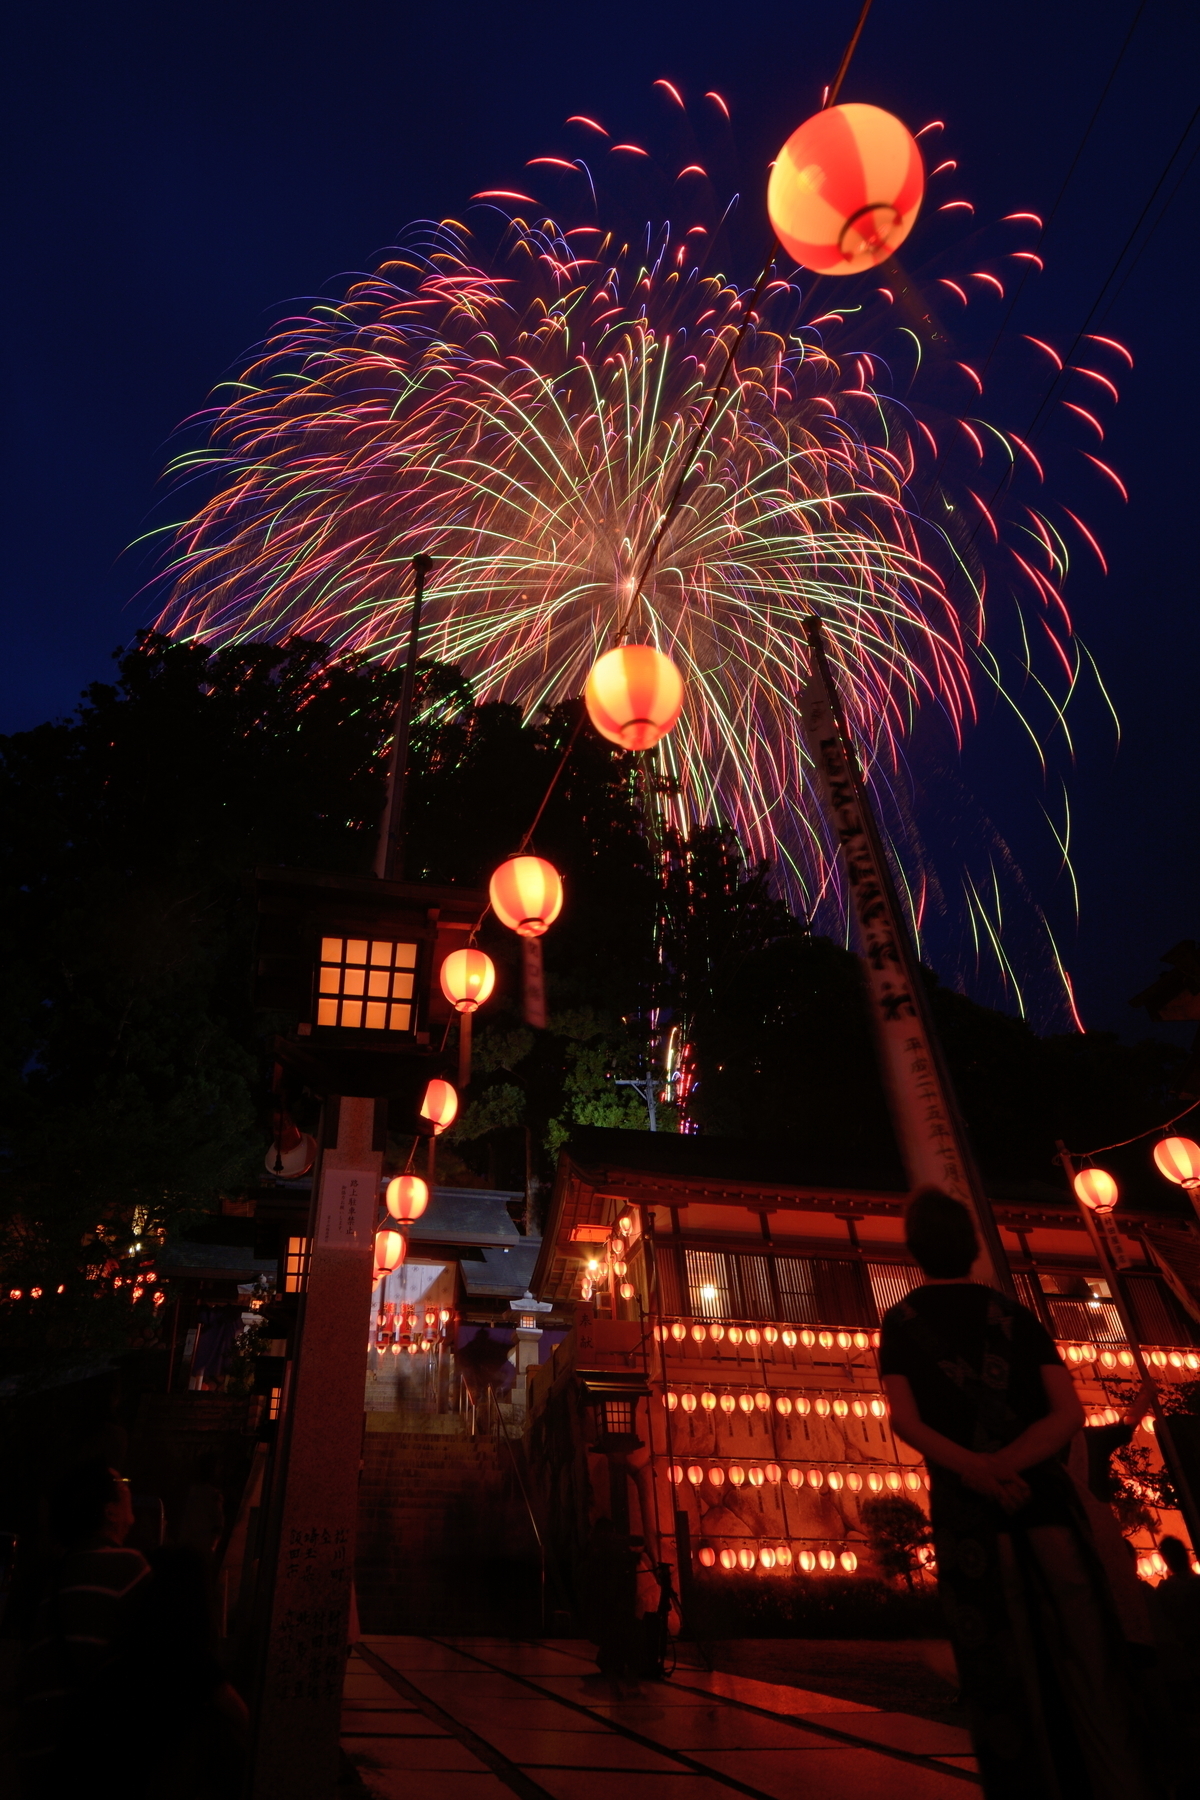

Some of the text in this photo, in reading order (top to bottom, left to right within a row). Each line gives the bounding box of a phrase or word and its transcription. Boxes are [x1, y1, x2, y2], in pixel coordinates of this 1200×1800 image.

[346, 1180, 358, 1235] 路上駐車禁止
[579, 1313, 594, 1350] 奉献
